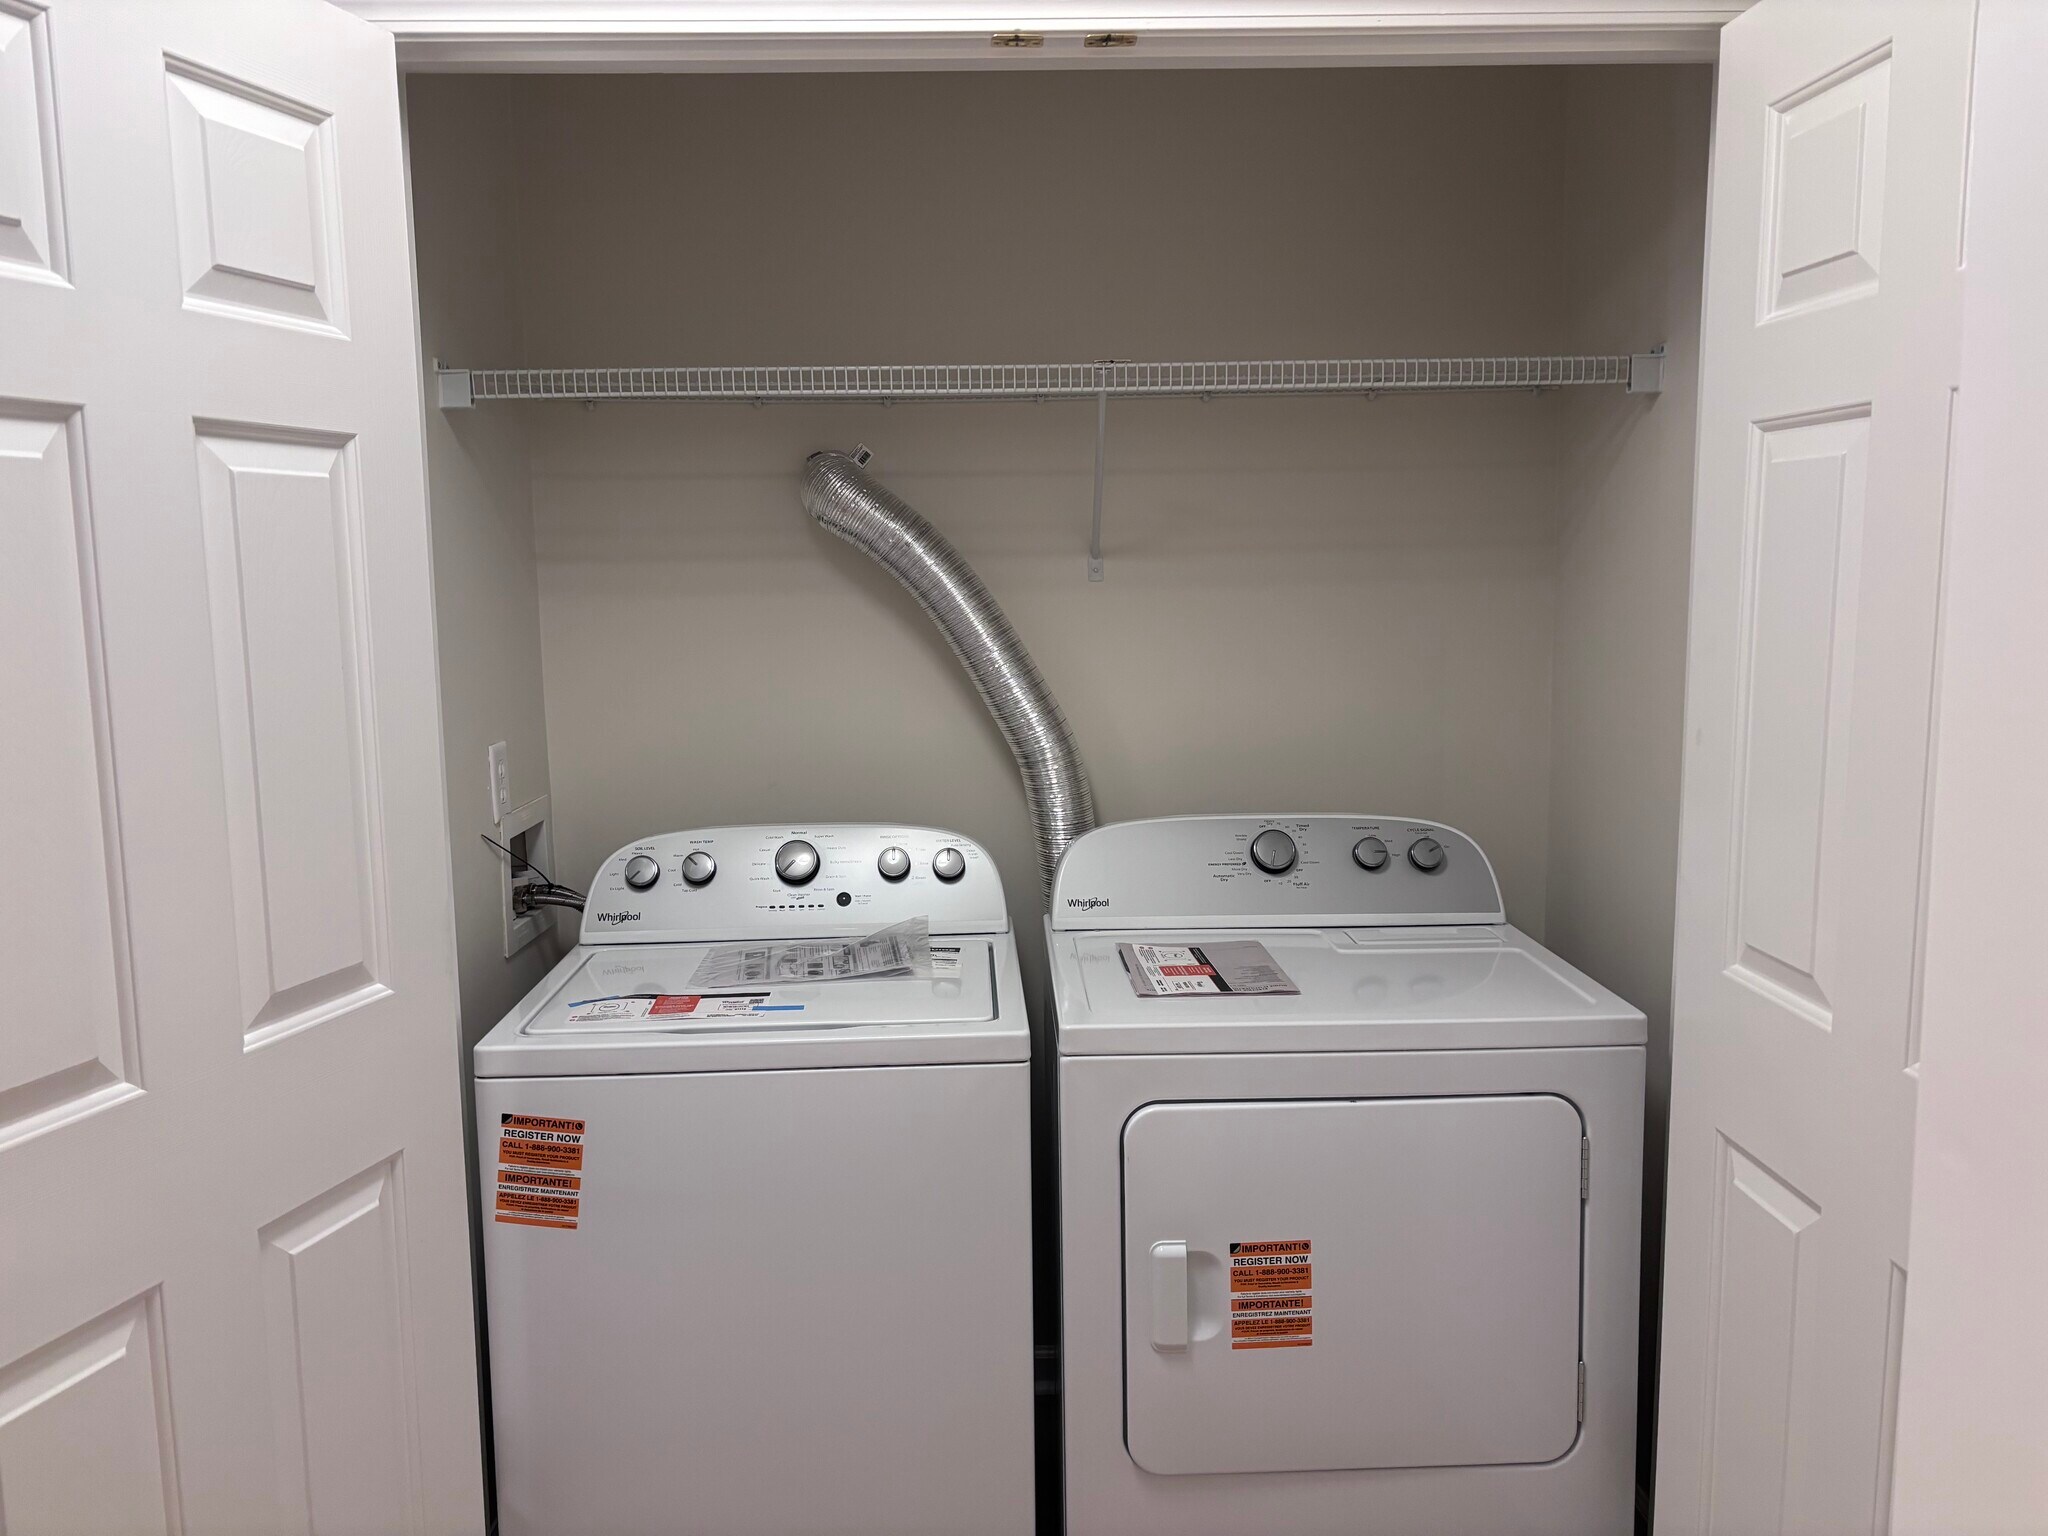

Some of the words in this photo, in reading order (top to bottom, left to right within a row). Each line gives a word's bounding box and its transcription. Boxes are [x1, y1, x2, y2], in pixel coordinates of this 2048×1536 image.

[1066, 896, 1110, 911] Whirlpool
[597, 910, 641, 925] Whirlpool
[513, 1116, 575, 1130] IMPORTANT!
[503, 1128, 554, 1141] REGISTER
[556, 1133, 581, 1143] NOW
[502, 1140, 523, 1149] CALL
[525, 1143, 580, 1155] 1-888-900-3381
[504, 1173, 572, 1188] IMPORTANTE!
[498, 1184, 539, 1193] ENREGISTREZ
[540, 1188, 579, 1197] MAINTENANT
[1241, 1243, 1301, 1253] IMPORTANT!
[1233, 1257, 1282, 1266] REGISTER
[1285, 1255, 1308, 1264] NOW
[1232, 1269, 1253, 1277] CALL
[1255, 1267, 1309, 1276] 1-888-900-3381
[1238, 1299, 1304, 1310] IMPORTANTE!
[1273, 1309, 1311, 1317] MAINTENANT
